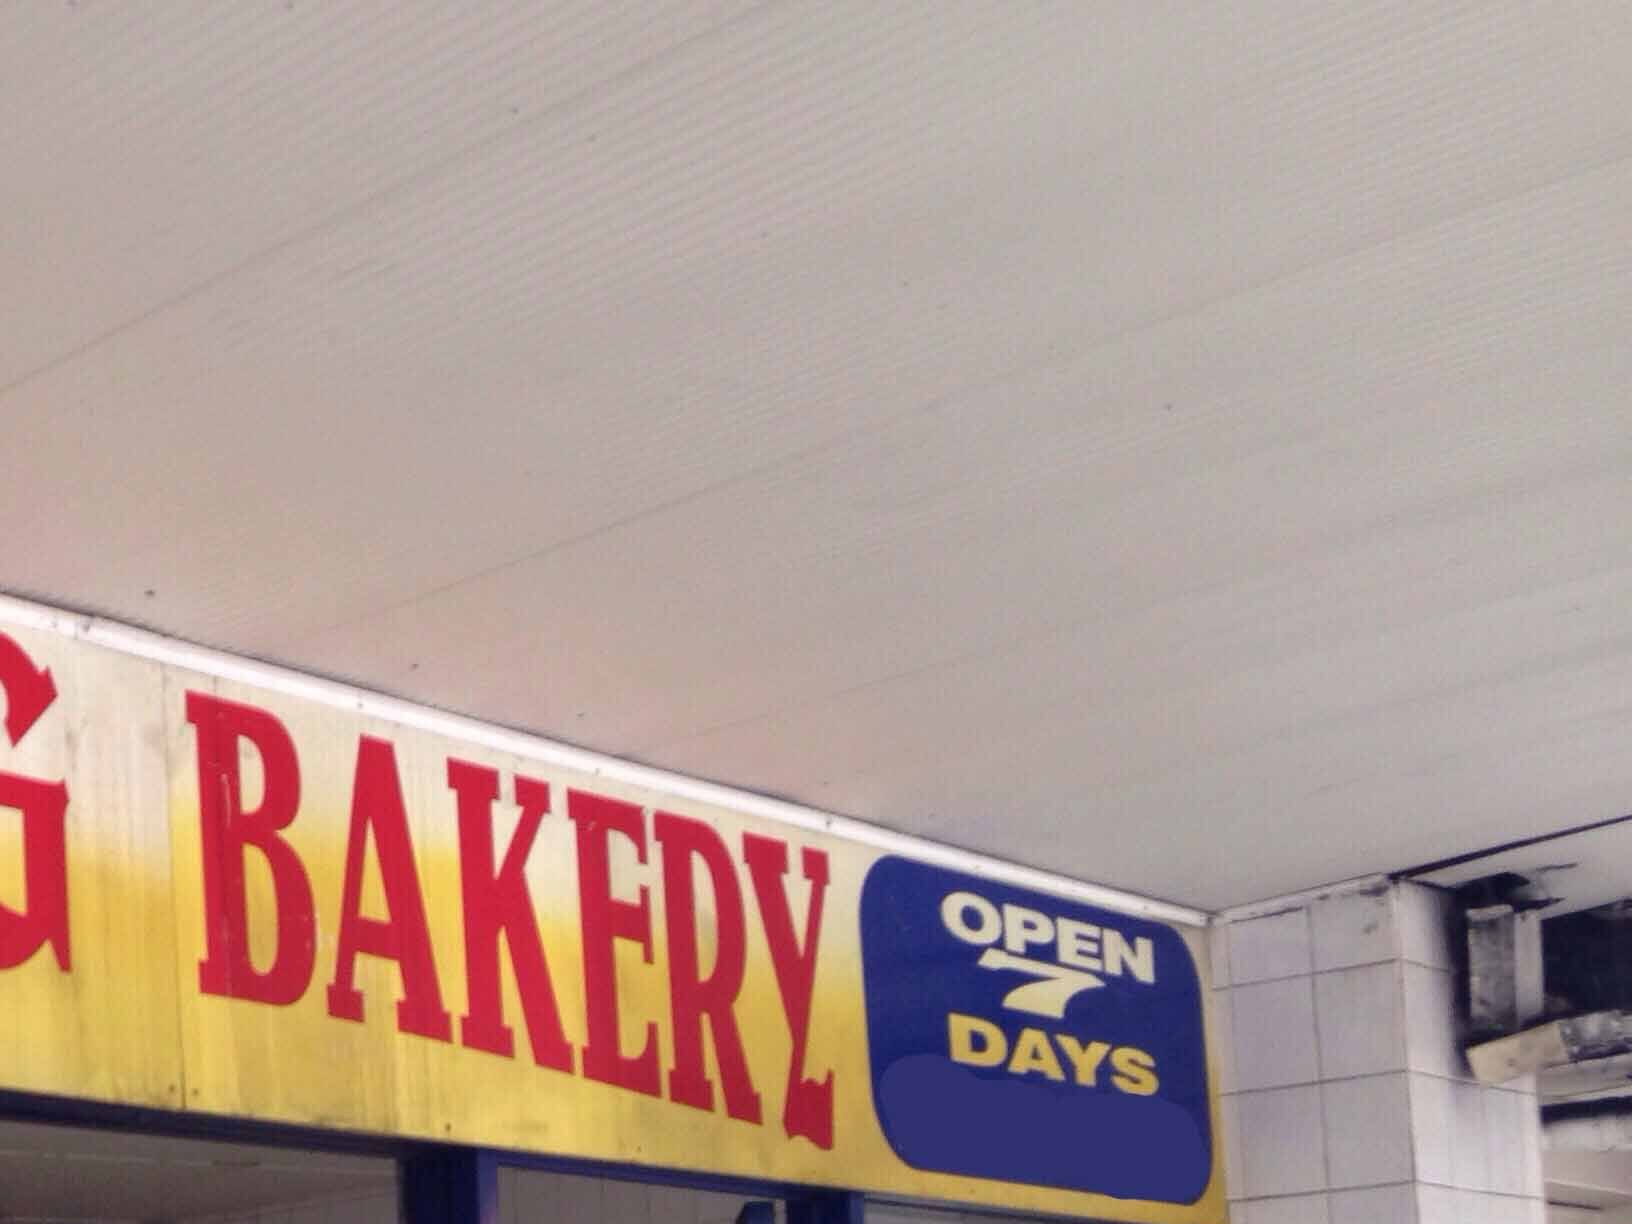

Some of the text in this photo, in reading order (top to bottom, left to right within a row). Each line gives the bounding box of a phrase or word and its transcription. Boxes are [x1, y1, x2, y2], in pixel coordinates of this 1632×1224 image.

[184, 689, 835, 1151] BAKERY
[941, 891, 1155, 984] OPEN
[977, 947, 1106, 1018] 7
[947, 1012, 1160, 1096] DAYS
